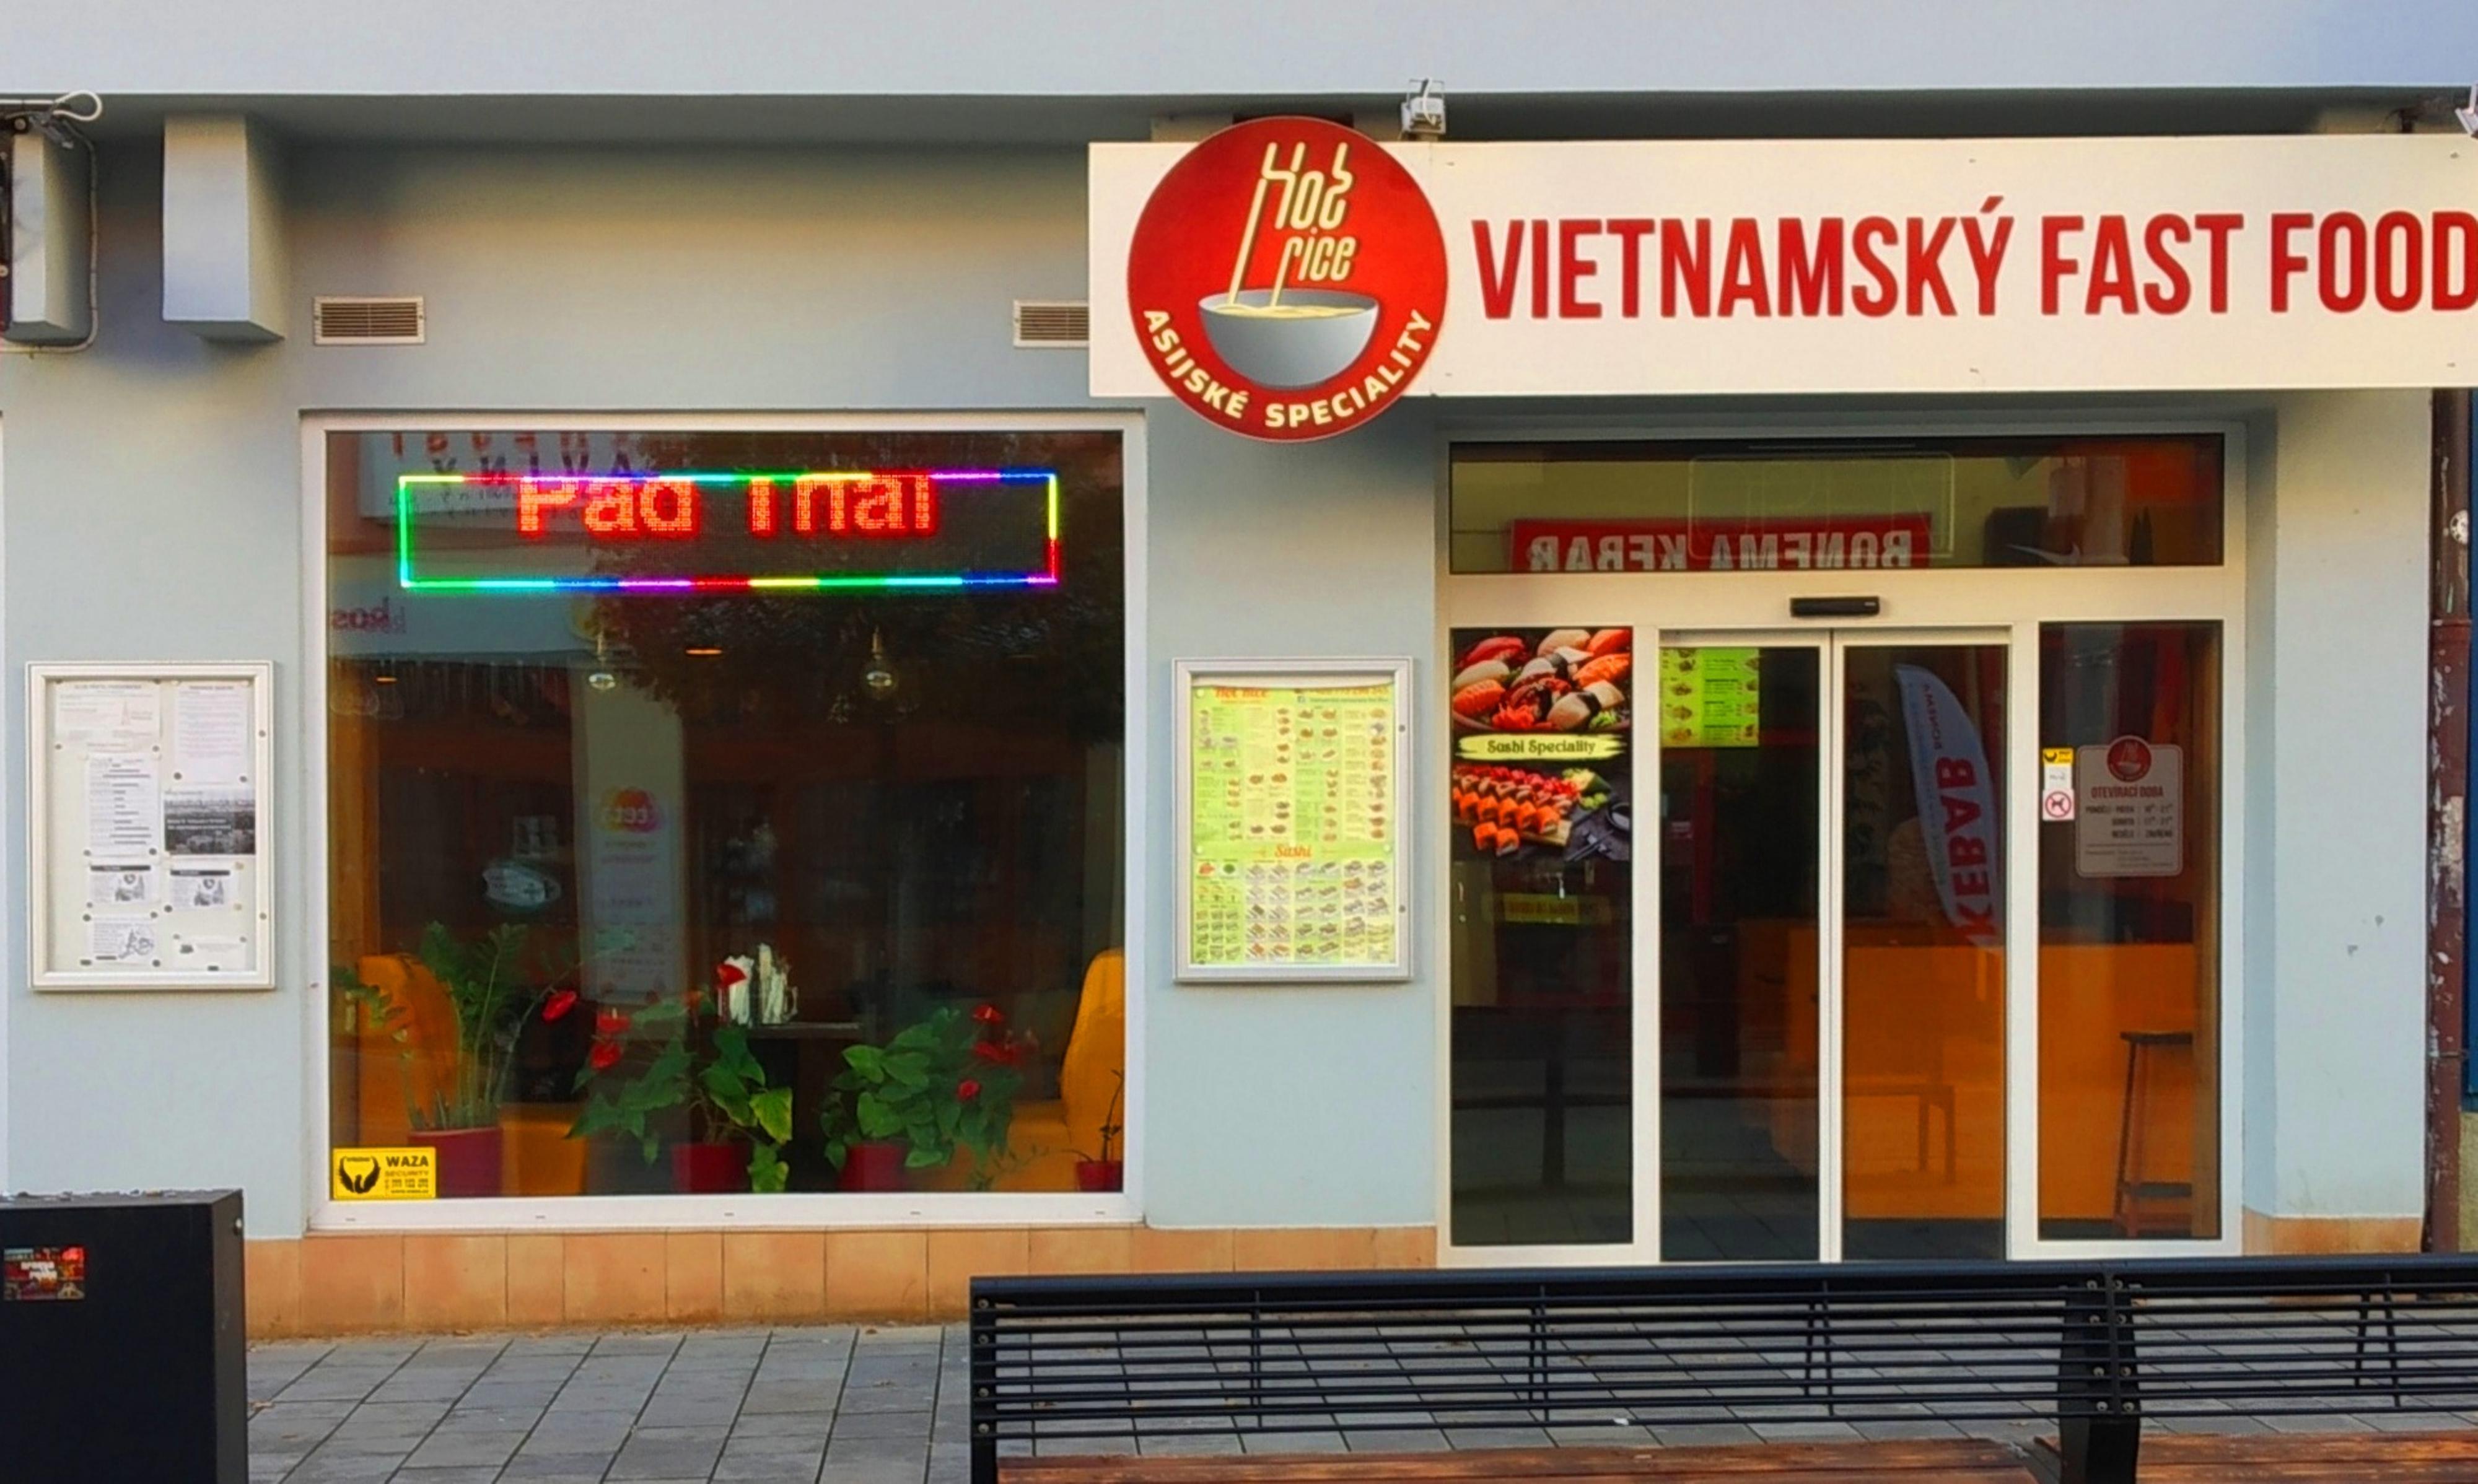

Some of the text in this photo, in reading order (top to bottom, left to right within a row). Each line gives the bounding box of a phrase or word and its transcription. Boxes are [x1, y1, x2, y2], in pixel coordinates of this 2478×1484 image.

[1271, 226, 1357, 307] rice
[1472, 196, 2478, 320] VIETNAMSKÝ FAST FOOD
[1143, 308, 1434, 430] ASIJSKÉ SPECIALITY
[1528, 740, 1595, 756] Speciality
[385, 1156, 429, 1167] WAZA
